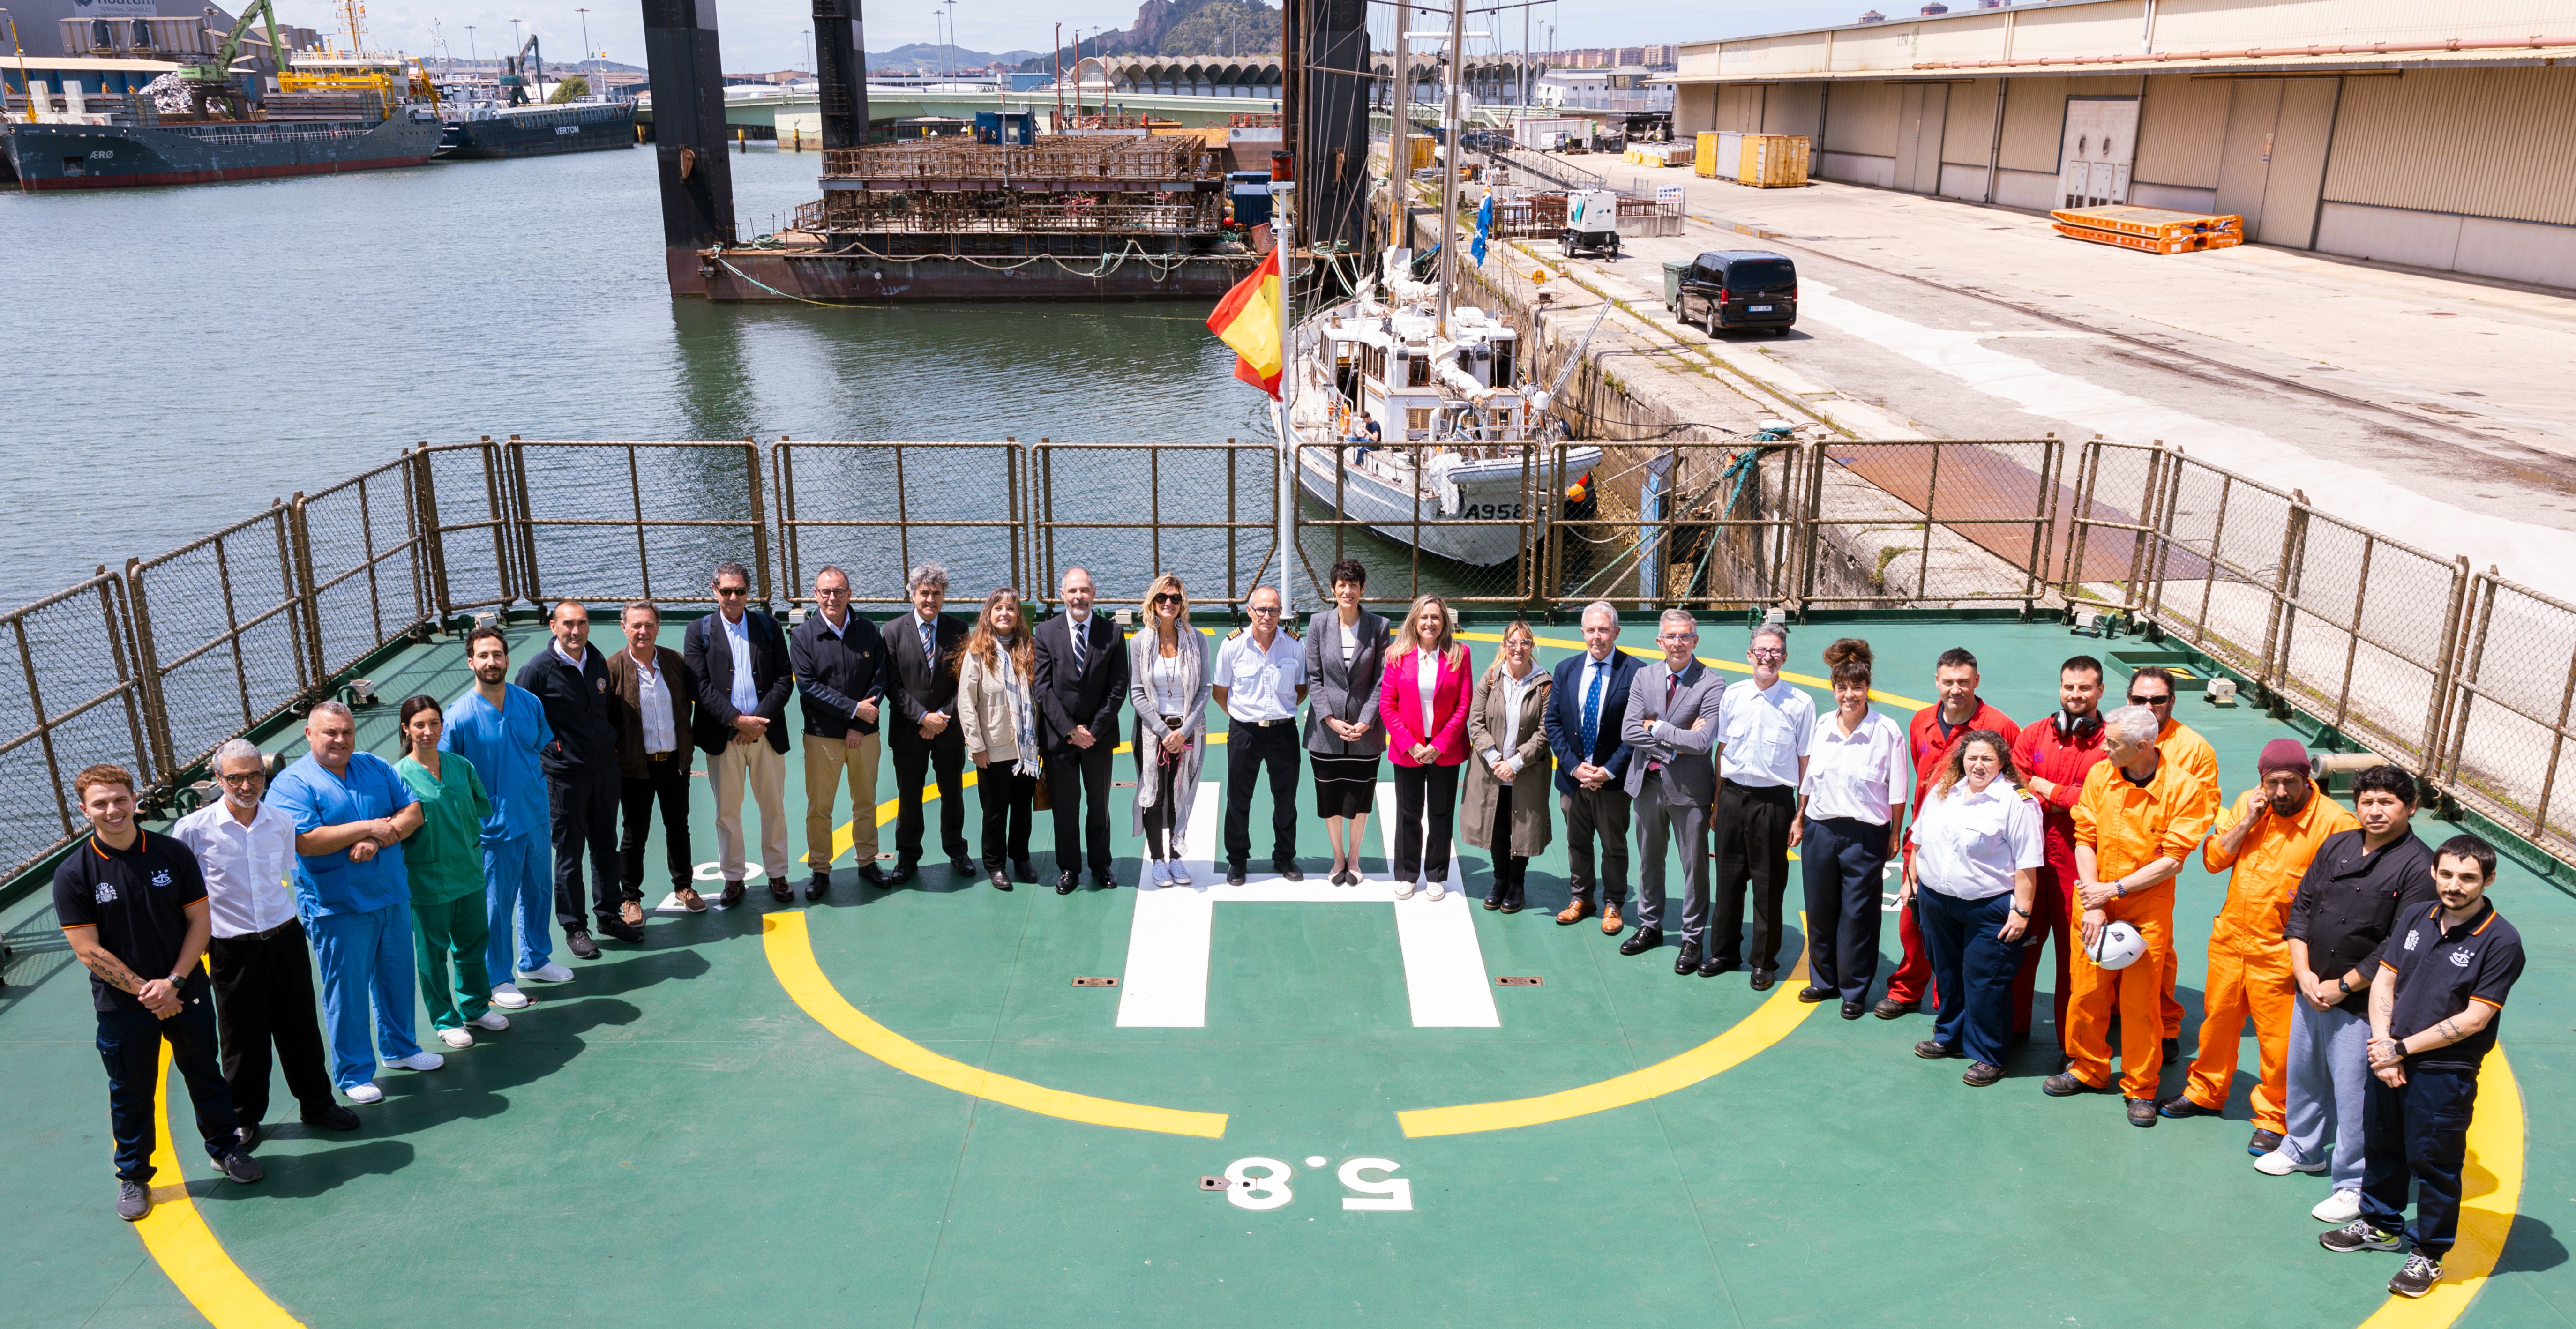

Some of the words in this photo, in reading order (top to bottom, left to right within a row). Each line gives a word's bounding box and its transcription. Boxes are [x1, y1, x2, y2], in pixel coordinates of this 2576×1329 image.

[554, 125, 579, 135] VERTOM
[90, 150, 113, 159] ÆRØ
[1116, 782, 1500, 1027] H
[1224, 1156, 1413, 1210] 5.8
